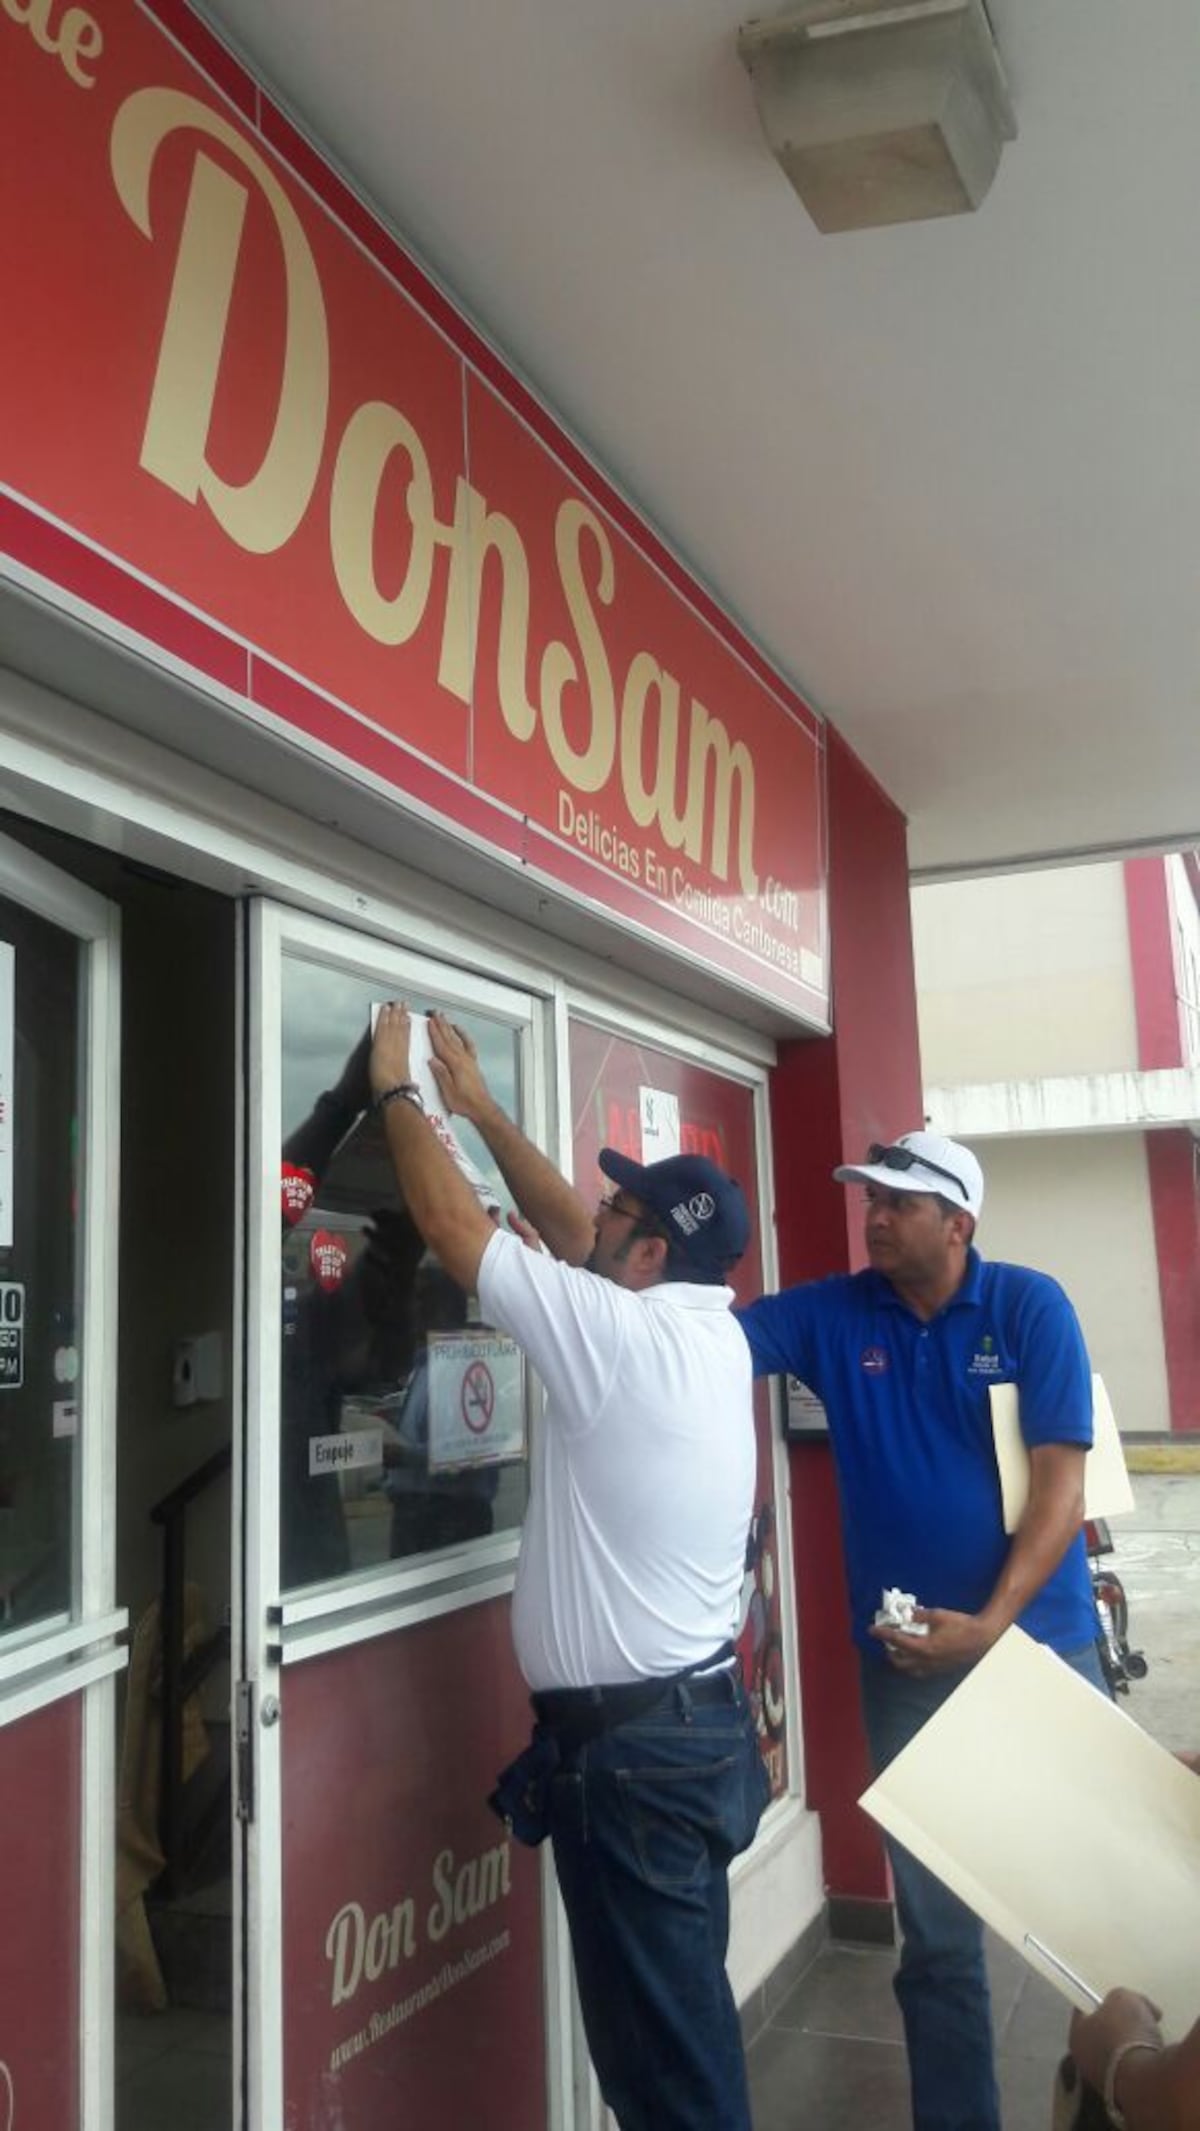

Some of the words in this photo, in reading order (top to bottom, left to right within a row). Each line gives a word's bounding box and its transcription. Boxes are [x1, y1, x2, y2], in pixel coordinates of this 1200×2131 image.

[558, 789, 640, 880] Delicias
[645, 849, 667, 897] En
[315, 1438, 354, 1465] Empuje
[325, 1900, 417, 2007] Don
[427, 1841, 511, 1942] Sam
